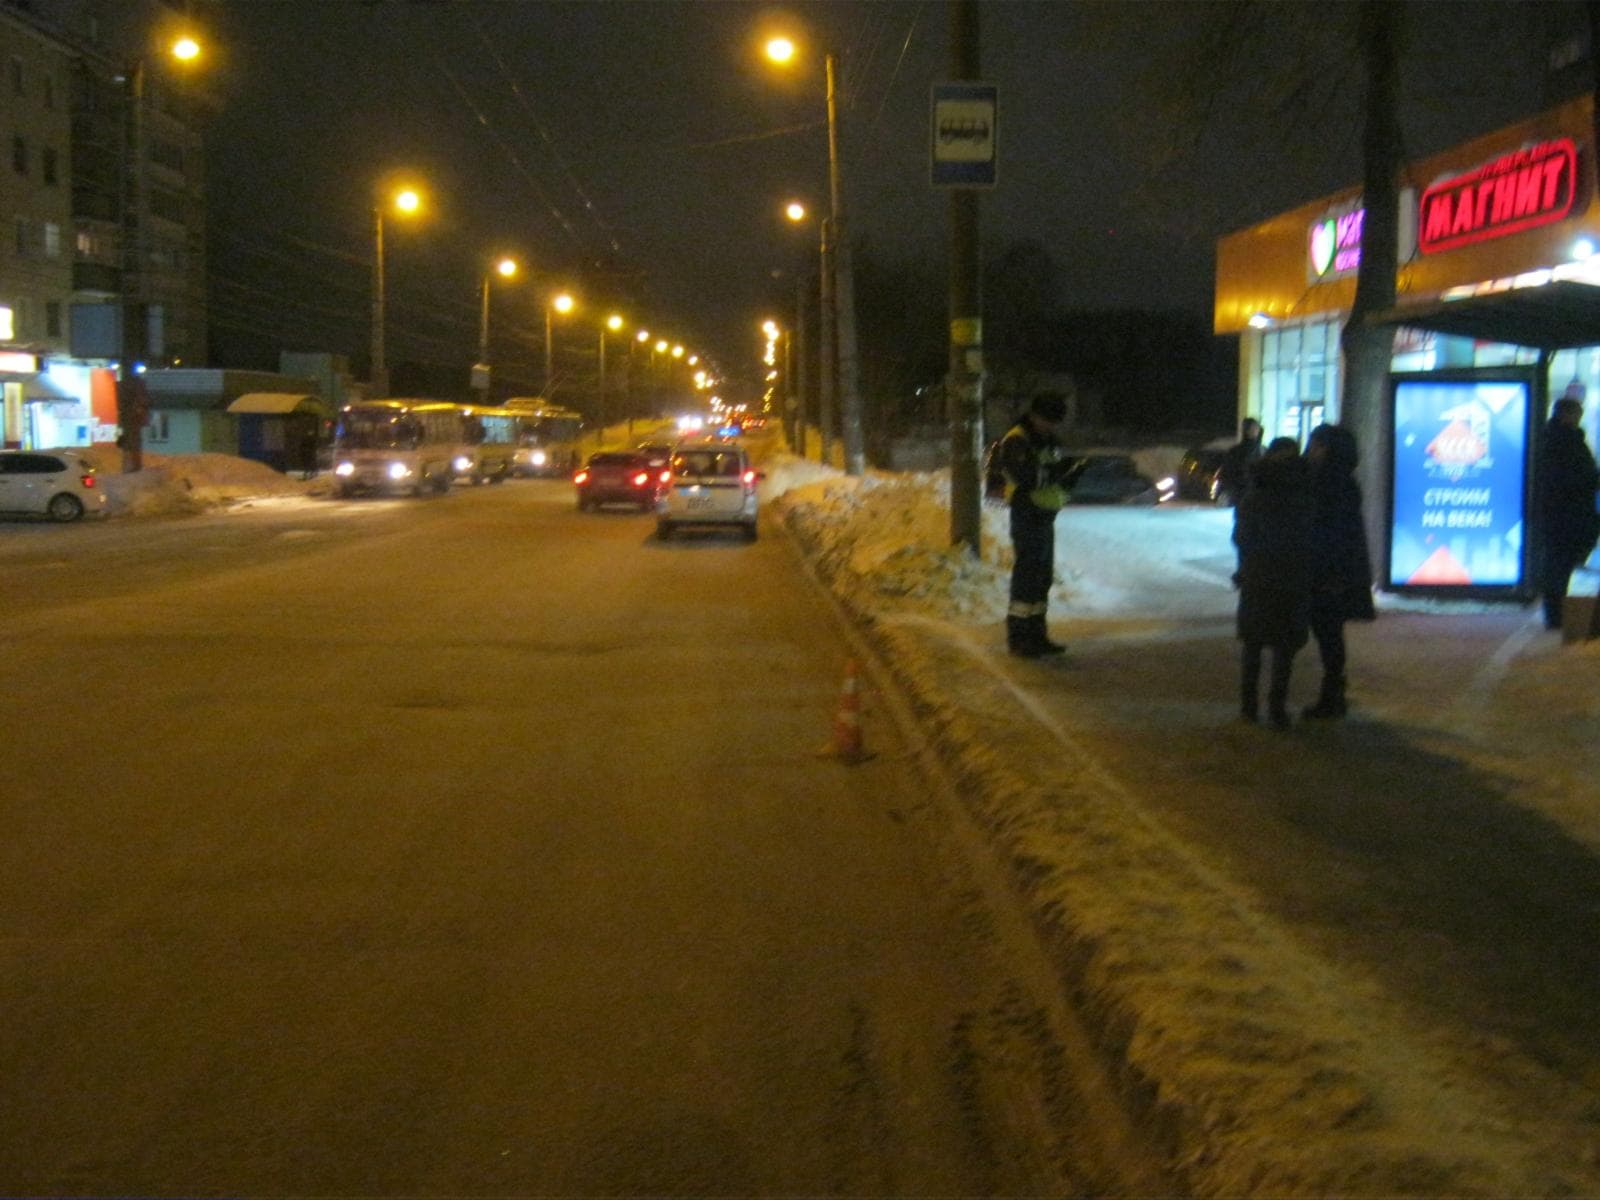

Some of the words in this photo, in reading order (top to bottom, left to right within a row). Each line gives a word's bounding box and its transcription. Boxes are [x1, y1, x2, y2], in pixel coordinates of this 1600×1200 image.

[1424, 154, 1566, 242] МАГНИТ
[1423, 487, 1491, 507] СТРОИМ
[1421, 509, 1445, 528] НА
